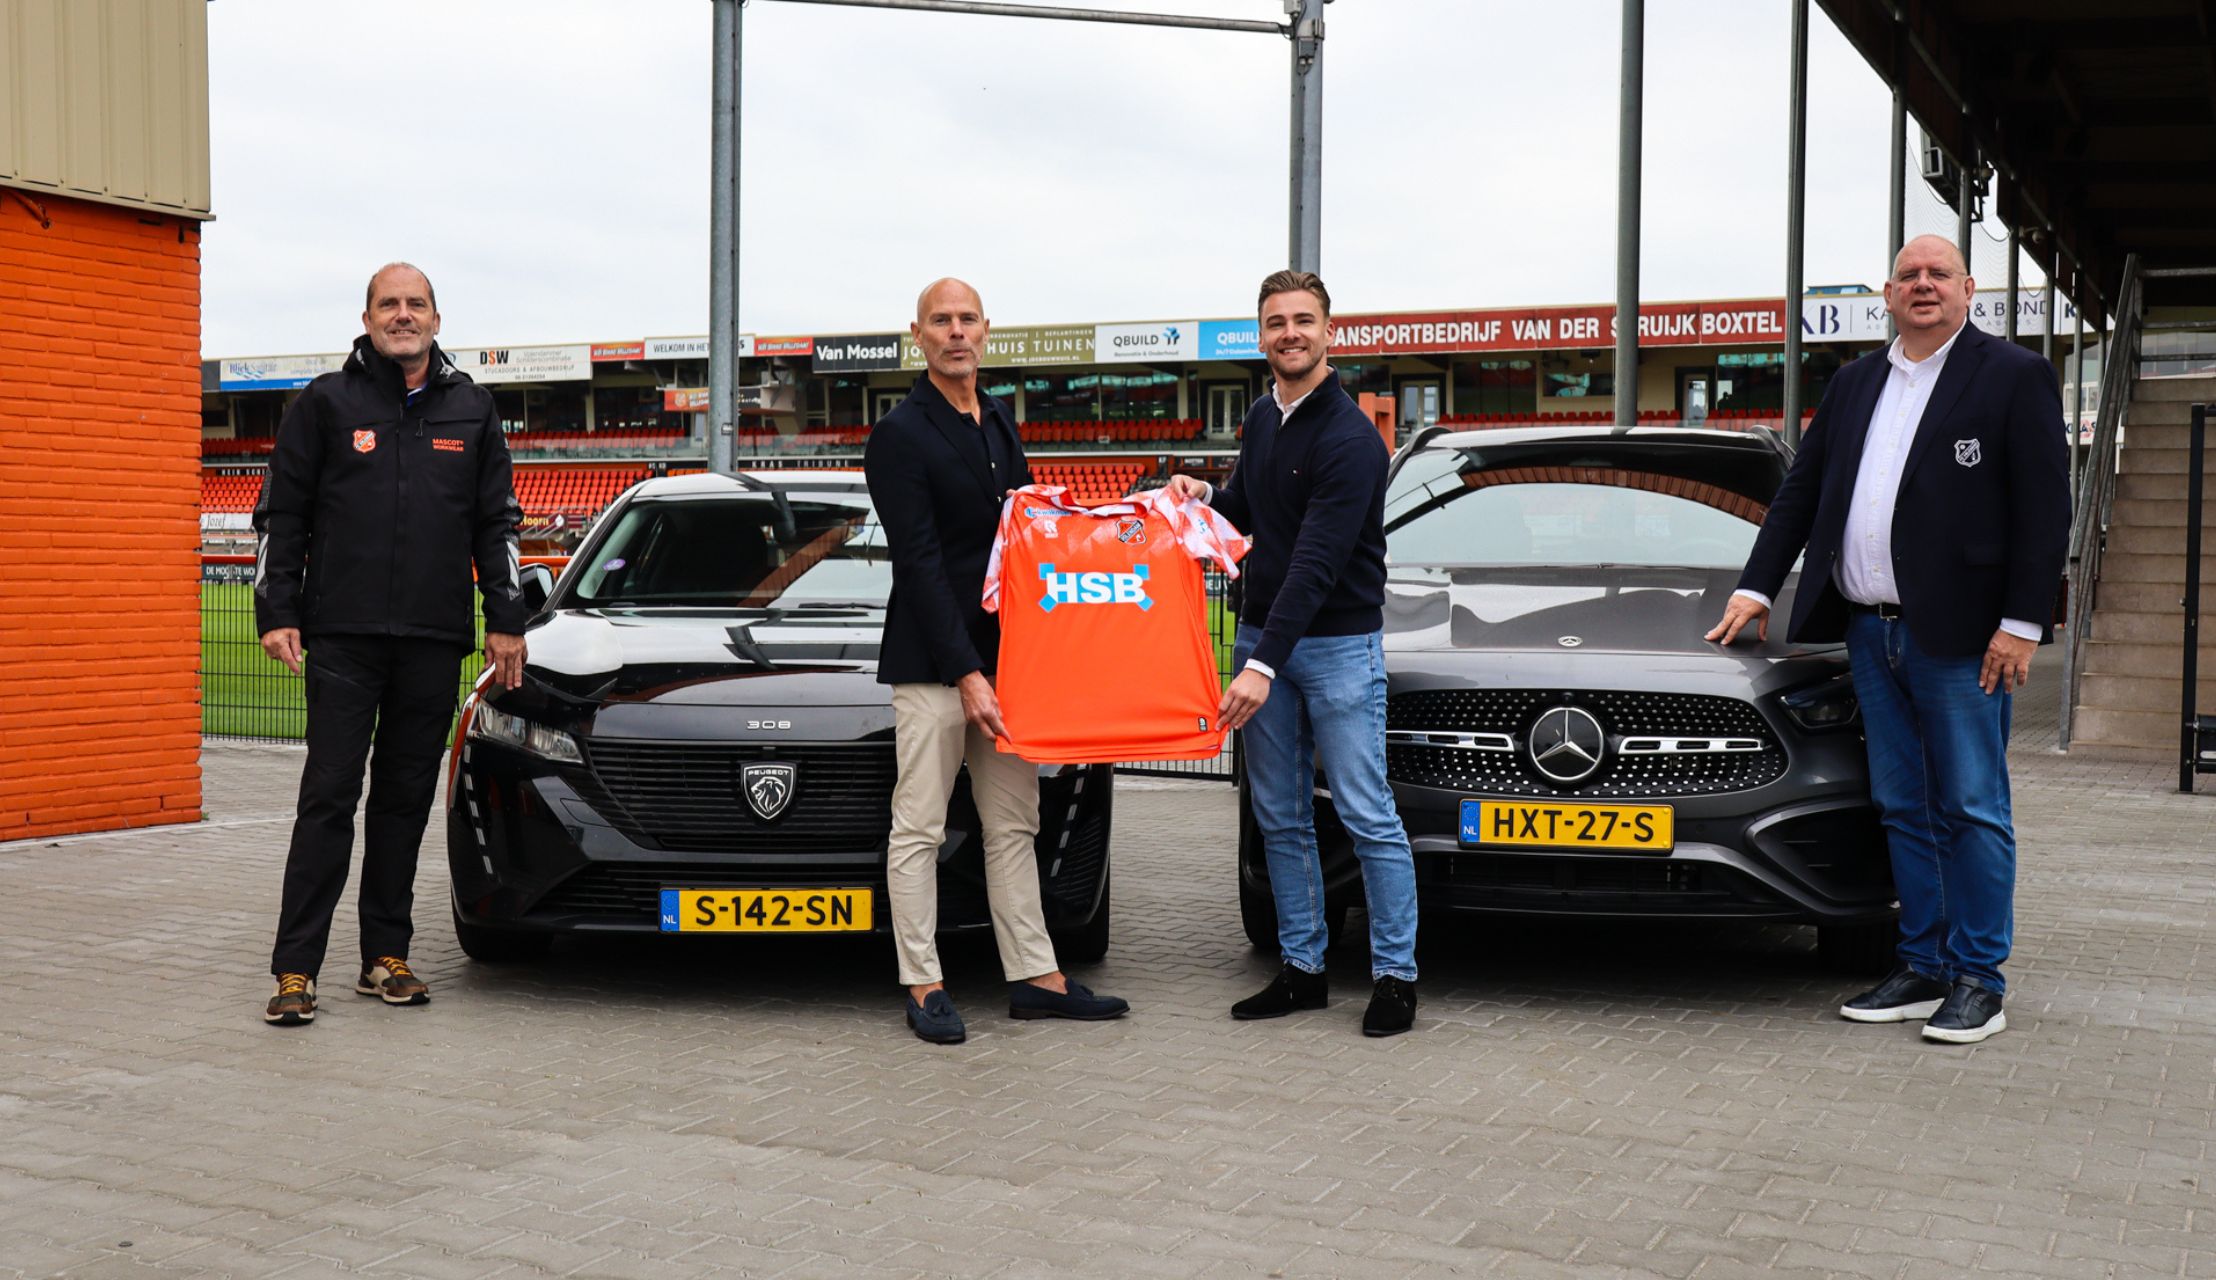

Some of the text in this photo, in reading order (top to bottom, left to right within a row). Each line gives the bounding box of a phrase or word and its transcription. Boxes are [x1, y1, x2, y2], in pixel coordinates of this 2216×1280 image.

[1331, 311, 1783, 347] ANSPORTBEDRIJF VAN DER SRUIJK BOXTEL
[1033, 338, 1096, 353] TUINEN
[1113, 334, 1159, 347] QBUILD
[1216, 331, 1259, 346] QBUIL
[653, 344, 686, 353] WELKOM
[687, 343, 695, 352] IN
[816, 345, 843, 361] Van
[847, 342, 898, 360] Mossel
[480, 349, 509, 366] DSW
[1046, 571, 1146, 604] HSB
[746, 719, 791, 730] 308
[748, 769, 790, 777] PEUGEOT
[1463, 807, 1654, 843] NL HXT-27-S
[663, 894, 853, 927] NL S-142-SN
